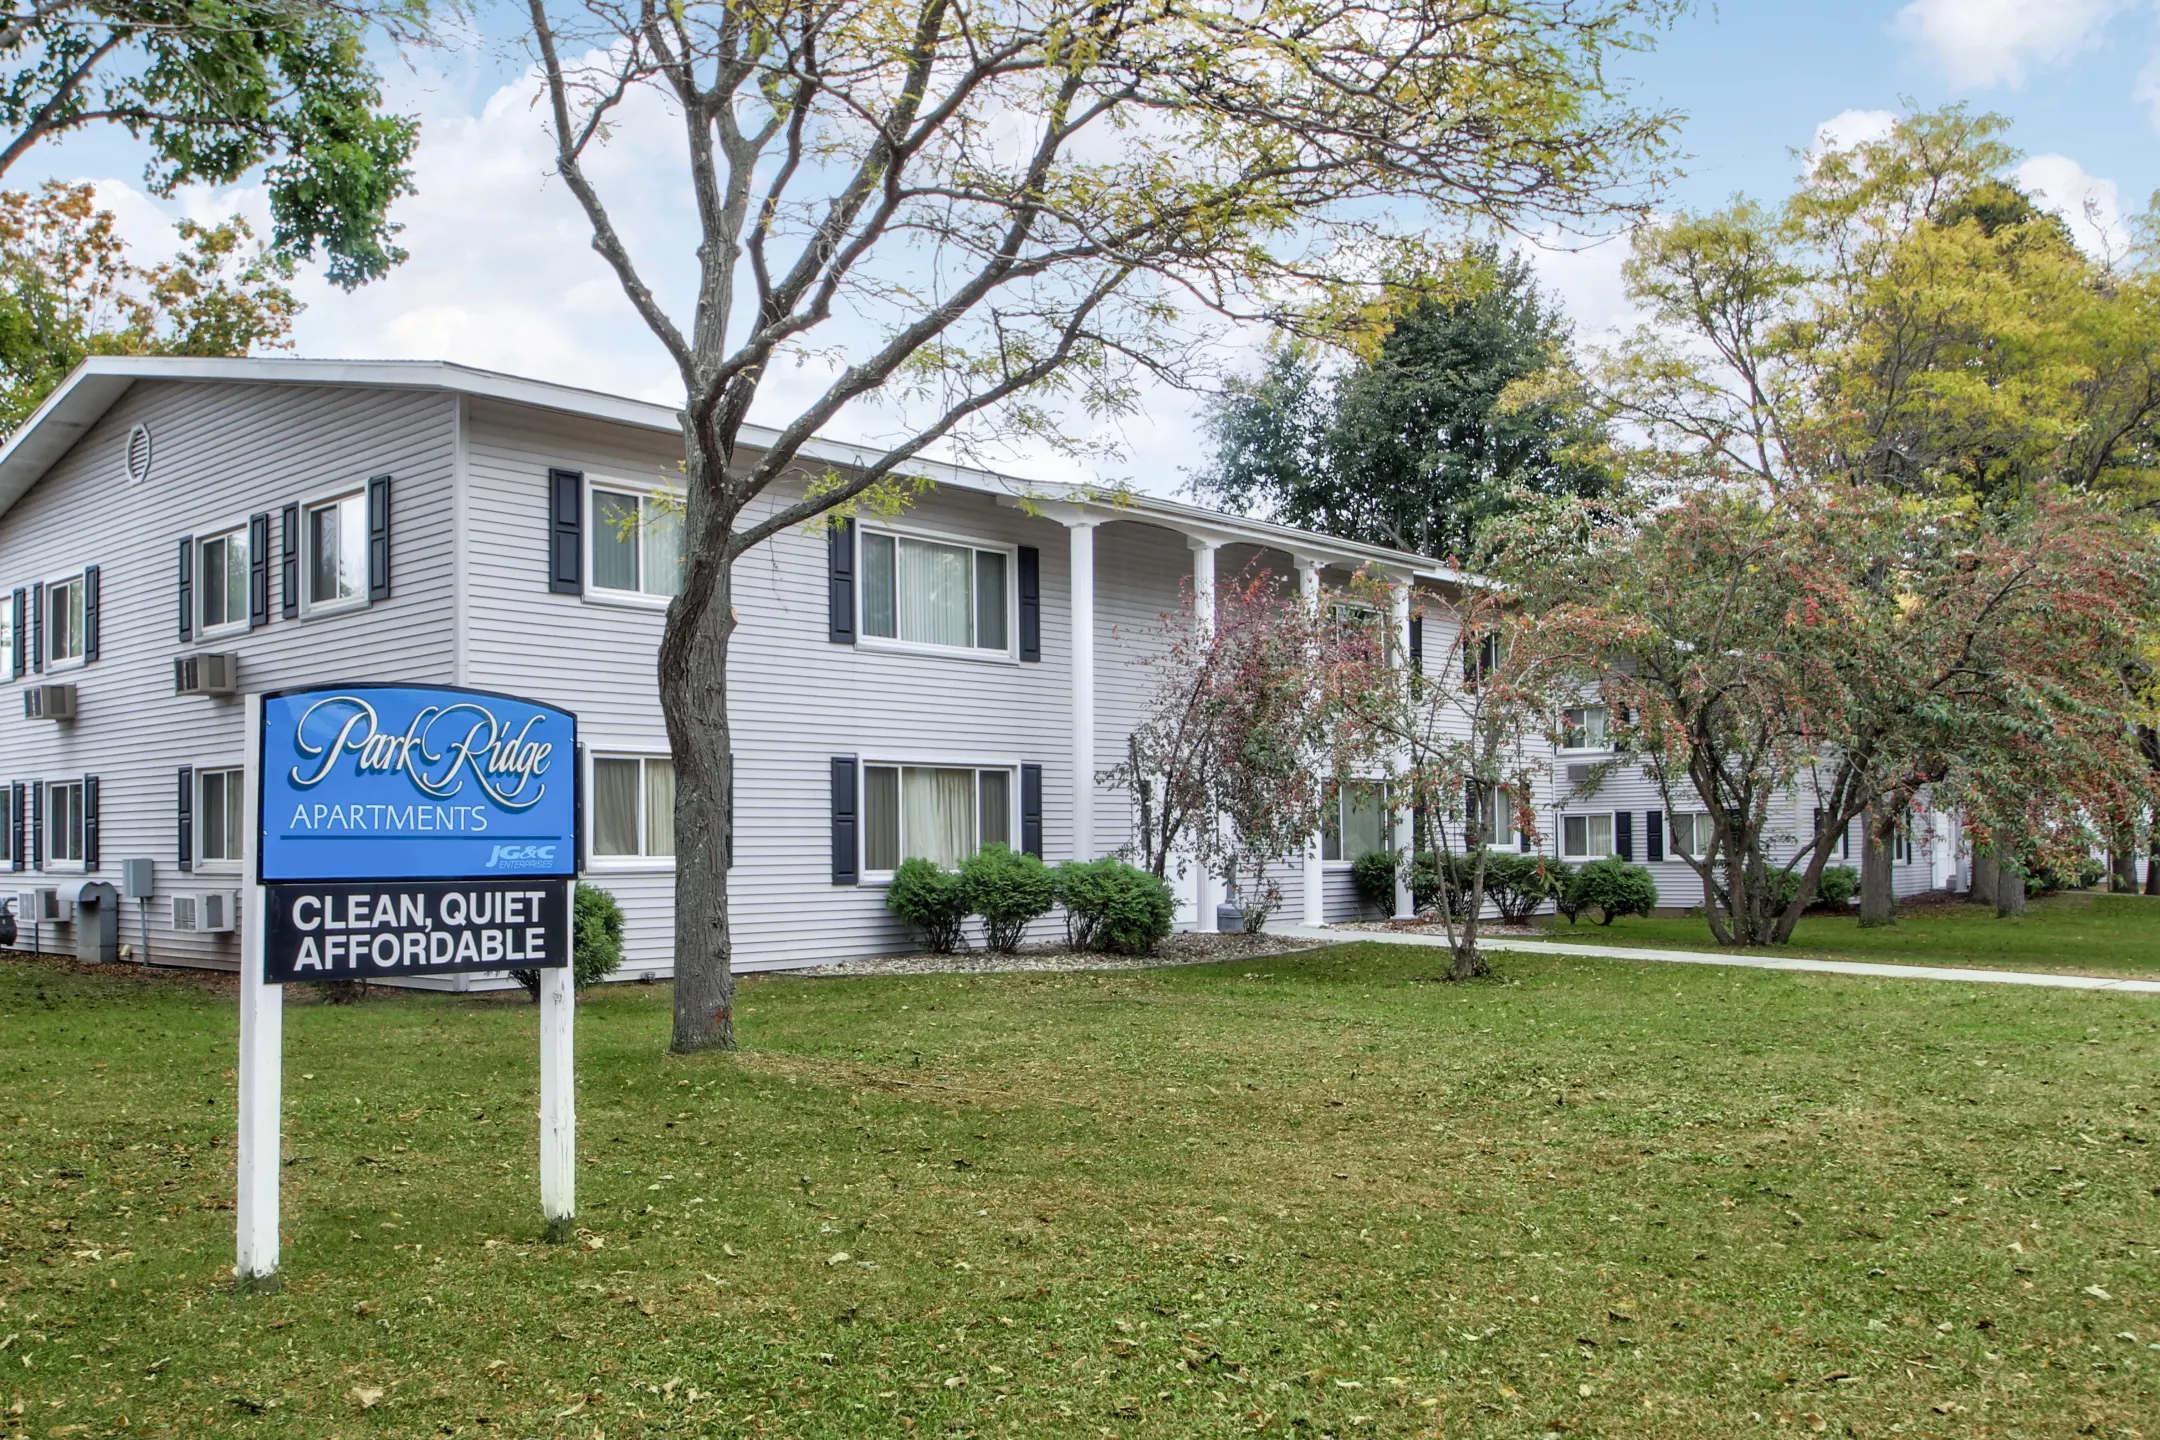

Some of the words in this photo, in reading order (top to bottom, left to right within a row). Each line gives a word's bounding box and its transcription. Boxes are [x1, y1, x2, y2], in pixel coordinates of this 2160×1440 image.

[292, 696, 463, 796] Park
[422, 703, 552, 808] Ridge
[290, 804, 488, 831] APARTMENTS
[485, 845, 556, 867] JG&C
[499, 860, 553, 869] ENTERPRISES
[292, 894, 433, 932] CLEAN,
[440, 891, 546, 926] QUIET
[293, 927, 546, 972] AFFORDABLE
